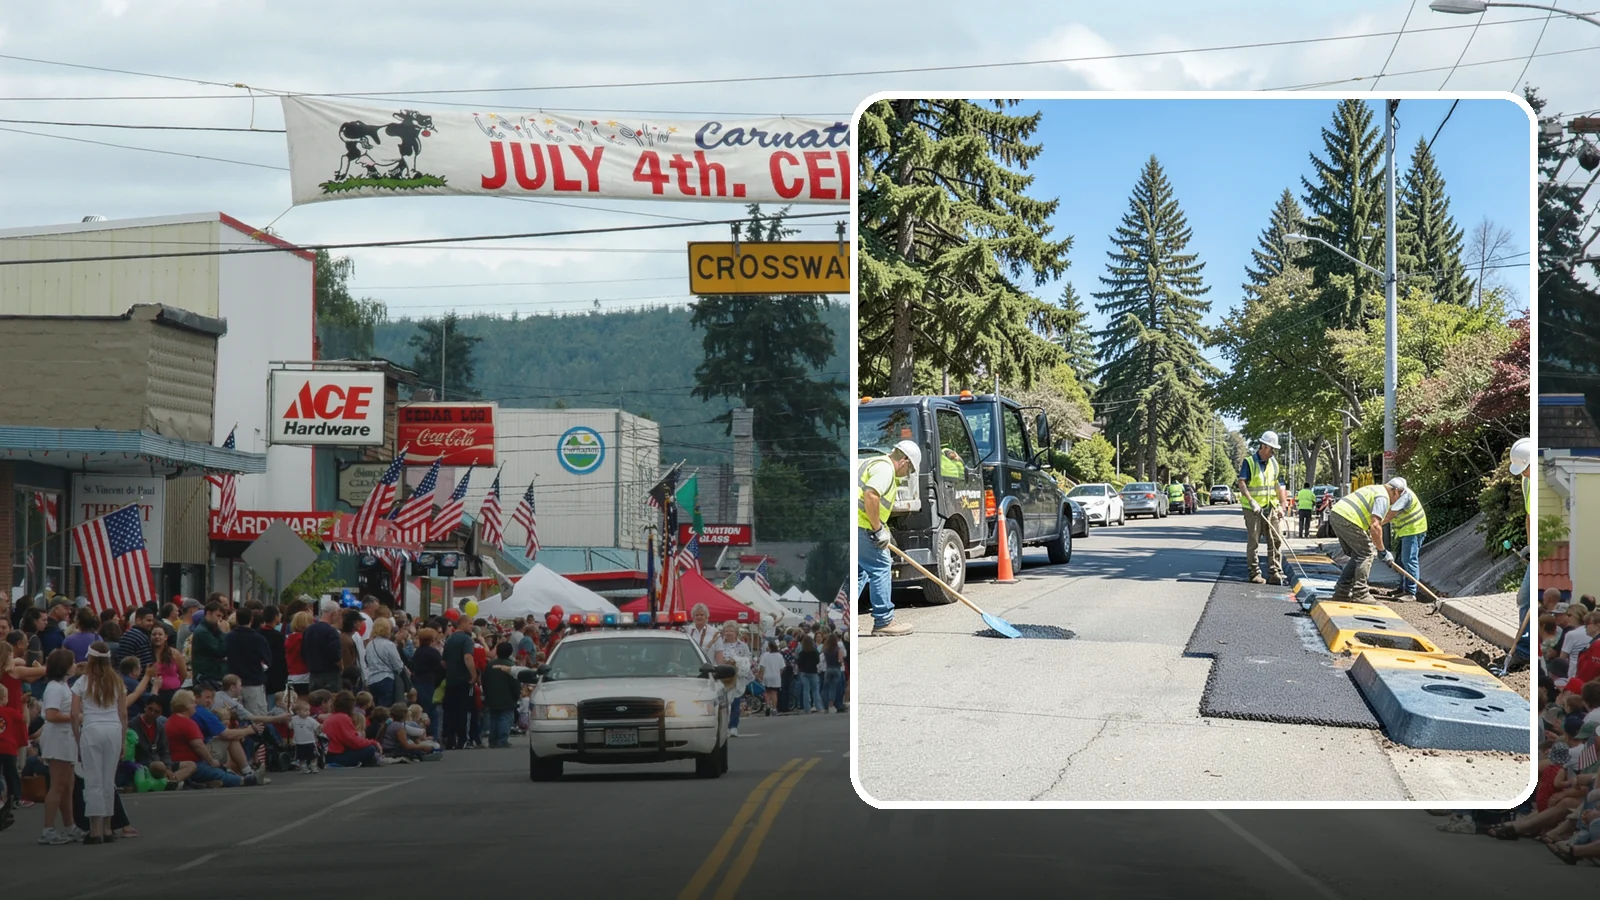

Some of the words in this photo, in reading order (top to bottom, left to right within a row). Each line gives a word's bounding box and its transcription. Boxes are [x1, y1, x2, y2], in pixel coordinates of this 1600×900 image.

[695, 121, 850, 150] Carnat
[481, 141, 605, 192] JULY
[632, 150, 746, 197] 4th.
[697, 254, 850, 280] CROSSWA
[283, 380, 374, 420] ACE
[406, 409, 452, 422] CEDAR
[284, 421, 371, 436] Hardware
[352, 466, 385, 482] Simpl
[83, 485, 94, 494] St.
[96, 485, 124, 495] Vincent
[126, 486, 136, 495] de
[137, 486, 155, 495] Paul
[212, 515, 331, 535] HARDARE
[688, 526, 742, 535] CRNATION
[699, 535, 730, 543] GLASS
